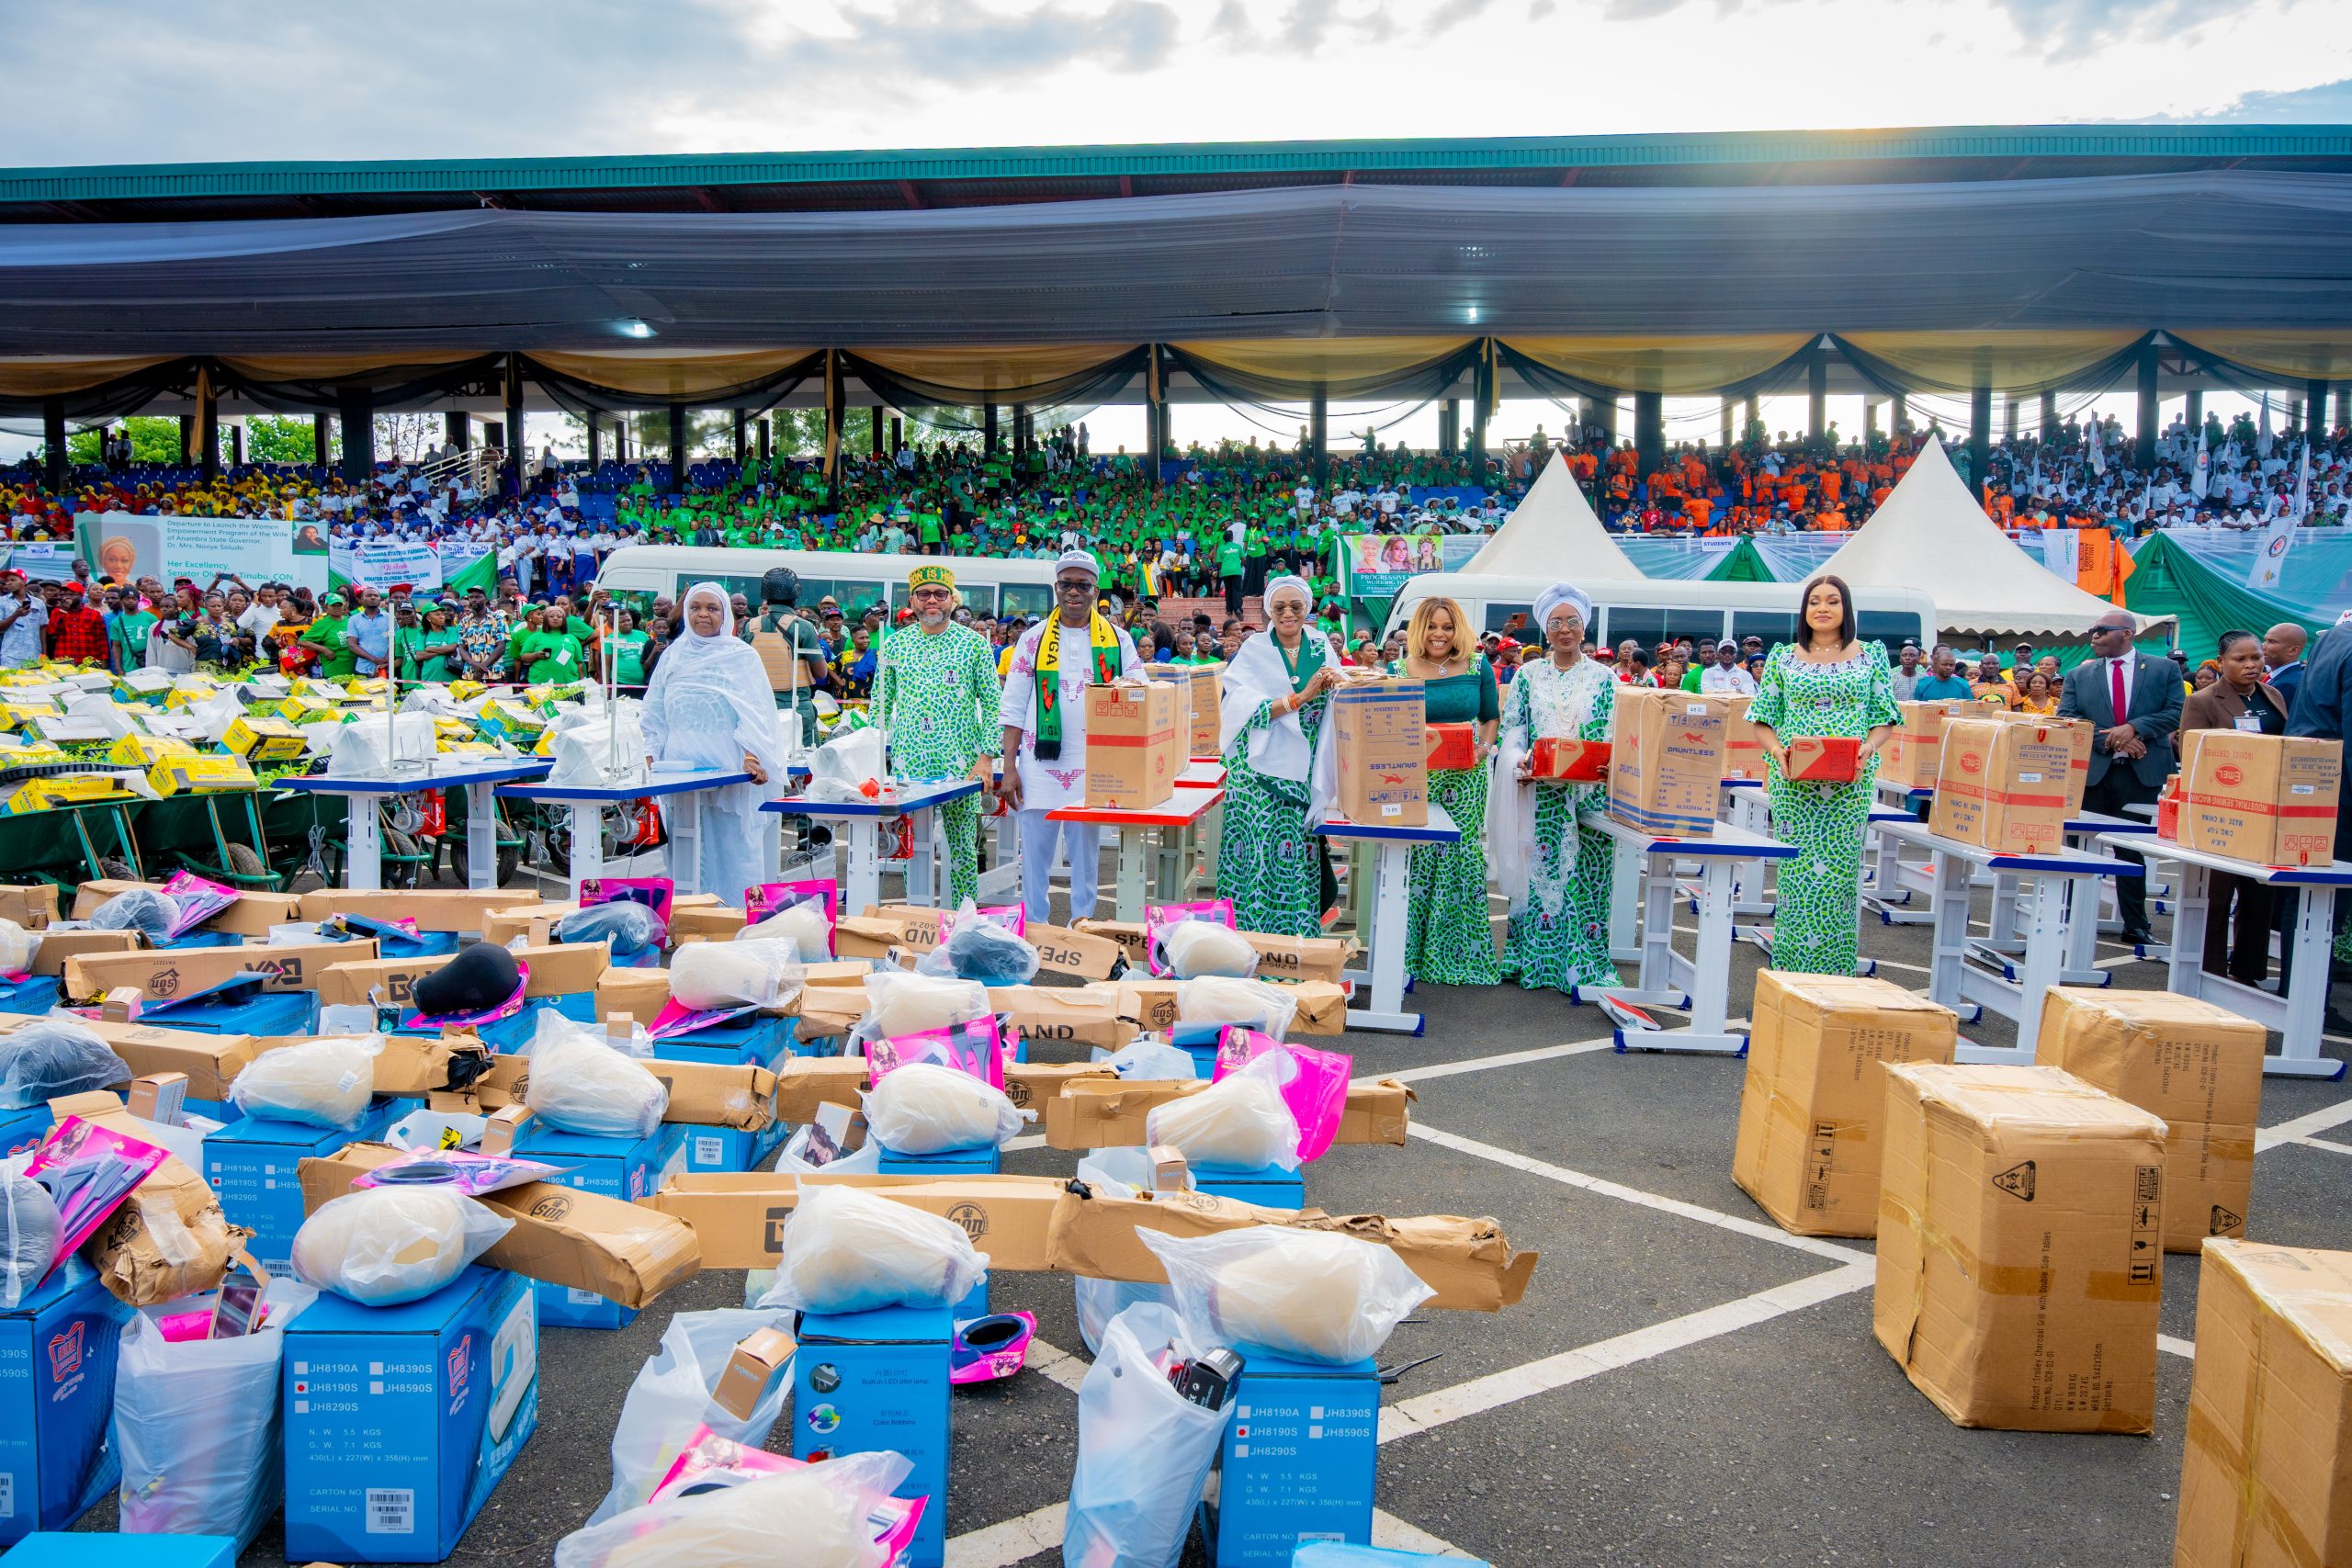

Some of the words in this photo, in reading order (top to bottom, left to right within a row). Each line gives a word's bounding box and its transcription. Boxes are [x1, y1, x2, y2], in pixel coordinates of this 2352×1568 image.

[185, 561, 231, 570] Excellency,
[167, 570, 199, 578] Senator
[1040, 726, 1058, 736] APGA
[1668, 746, 1714, 756] DAUNTLESS
[2187, 794, 2211, 806] MACHINE
[2212, 796, 2235, 808] SEWING
[2235, 799, 2268, 813] INDUSTRIAL
[2201, 814, 2218, 822] CHINA
[2228, 818, 2244, 827] MADE
[222, 1165, 257, 1173] JH8190A
[2028, 1168, 2036, 1193] CAUTION
[2137, 1168, 2150, 1201] FRAGILE
[2041, 1232, 2051, 1252] Tables
[2040, 1256, 2050, 1269] Side
[2039, 1272, 2049, 1293] Double
[2037, 1296, 2047, 1310] with
[2036, 1314, 2045, 1325] Grill
[2034, 1328, 2044, 1357] Charcoal
[310, 1364, 359, 1373] JH8190A
[384, 1364, 433, 1373] JH8390S
[2032, 1359, 2043, 1382] Trolley
[2069, 1373, 2078, 1382] KG
[310, 1383, 358, 1393] JH8190S
[384, 1383, 433, 1393] JH8590S
[2042, 1396, 2052, 1411] Item
[2103, 1390, 2113, 1412] Carton
[310, 1403, 358, 1412] JH8290S
[1252, 1408, 1300, 1417] JH8190A
[1324, 1408, 1372, 1417] JH8390S
[1250, 1427, 1298, 1437] JH8190S
[1323, 1428, 1370, 1438] JH8590S
[1250, 1447, 1297, 1456] JH8290S
[310, 1488, 346, 1496] CARTON
